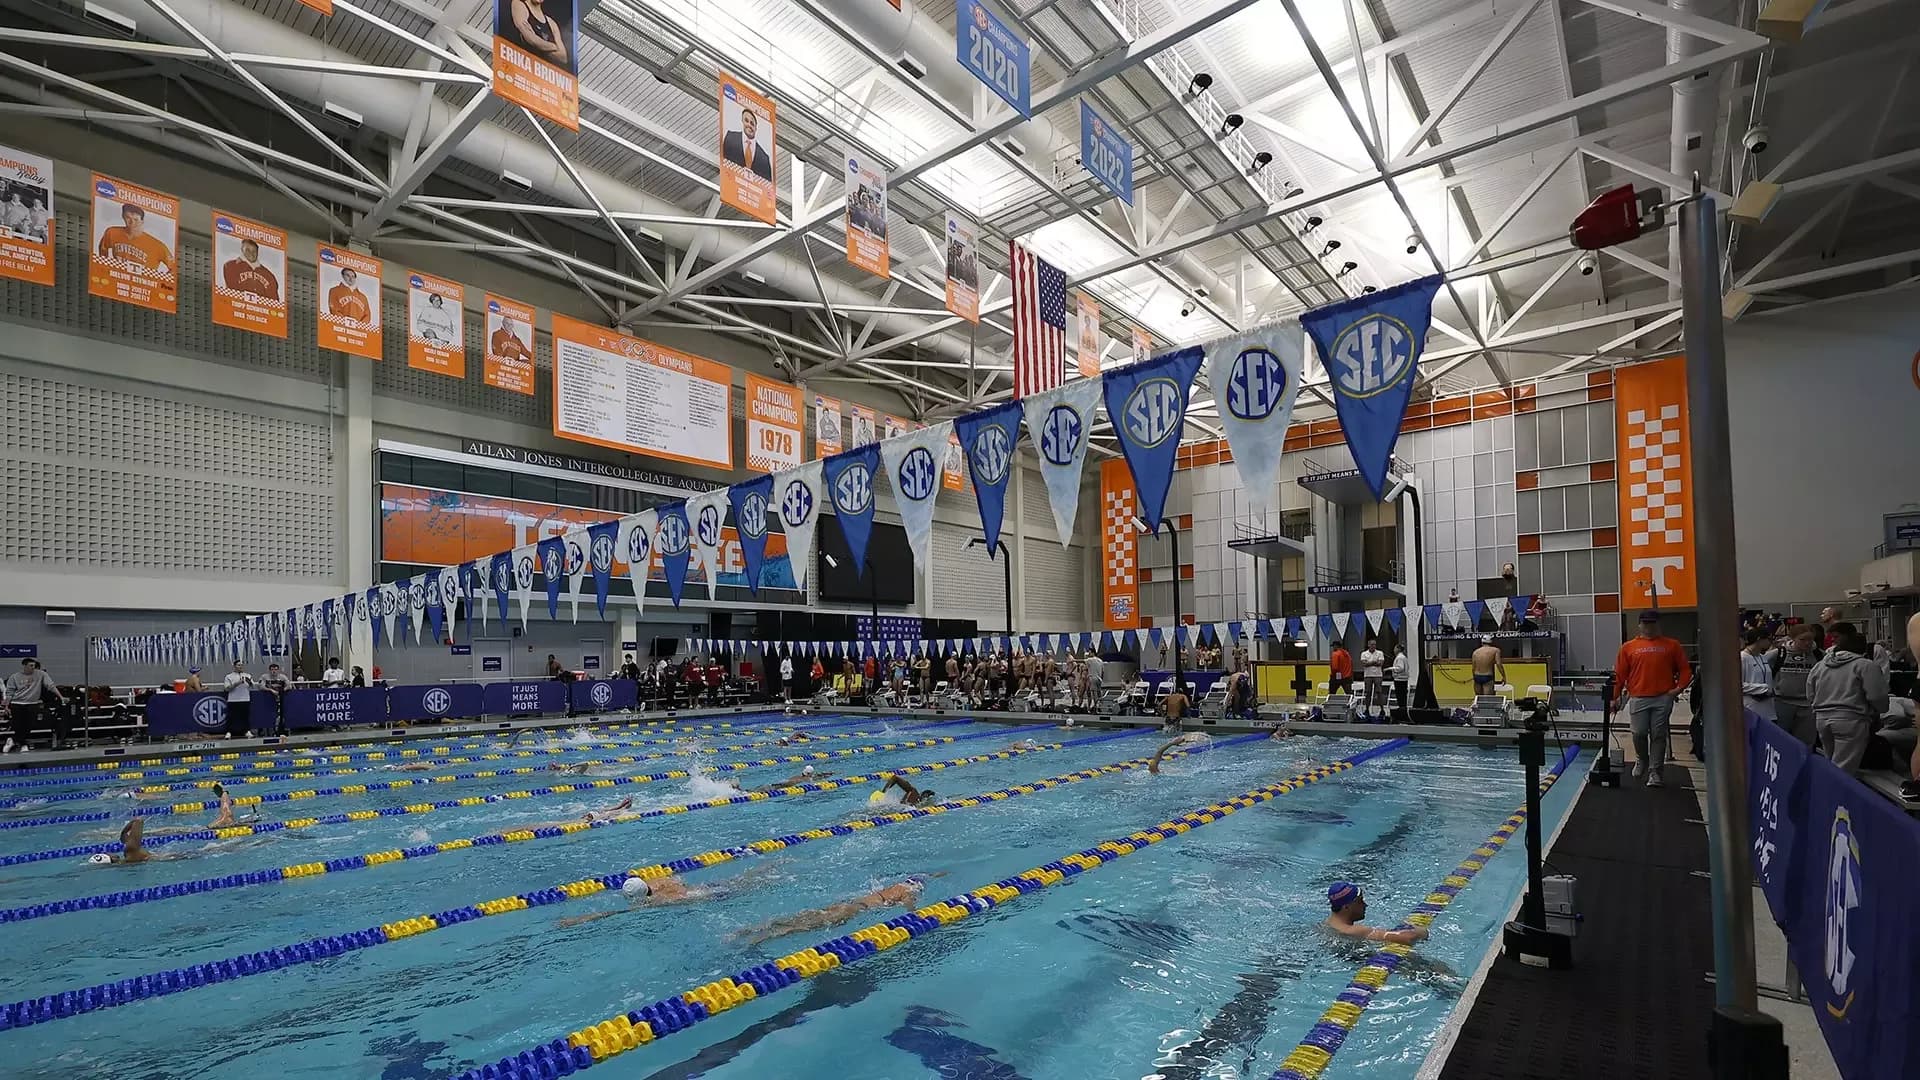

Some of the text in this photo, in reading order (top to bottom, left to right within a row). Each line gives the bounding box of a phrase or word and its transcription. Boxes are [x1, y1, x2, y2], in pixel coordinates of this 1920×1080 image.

[500, 43, 532, 73] ERIKA
[534, 60, 573, 93] BROWN
[969, 25, 1019, 100] 2020
[17, 168, 47, 184] Relay
[1090, 134, 1125, 193] 2022
[118, 189, 173, 214] CHAMPIONS
[235, 223, 281, 246] CHAMPIONS
[336, 254, 377, 274] CHAMPIONS
[424, 280, 460, 298] CHAMPIONS
[658, 353, 693, 373] OLYMPIANS
[1335, 320, 1405, 392] SEC
[757, 385, 793, 409] NATIONAL
[1229, 350, 1283, 417] SEC
[752, 399, 798, 425] CHAMPIONS
[1126, 382, 1178, 445] SEC
[759, 428, 793, 456] 1978
[974, 427, 1008, 483] SEC
[468, 441, 517, 460] ALLAN
[522, 451, 563, 467] JONES
[567, 460, 674, 486] INTERCOLLEGIATE
[771, 459, 781, 470] T
[901, 449, 934, 499] SEC
[1332, 470, 1353, 479] MEANS
[837, 466, 871, 511] SEC
[743, 495, 766, 536] SEC
[784, 482, 812, 525] SEC
[661, 516, 689, 553] SEC
[592, 536, 613, 571] SEC
[1632, 557, 1684, 596] T
[316, 692, 350, 701] IT JUST
[316, 702, 351, 711] MEANS
[425, 691, 449, 713] SEC
[512, 693, 539, 701] MEANS
[592, 684, 611, 703] SEC
[197, 699, 227, 724] SEC
